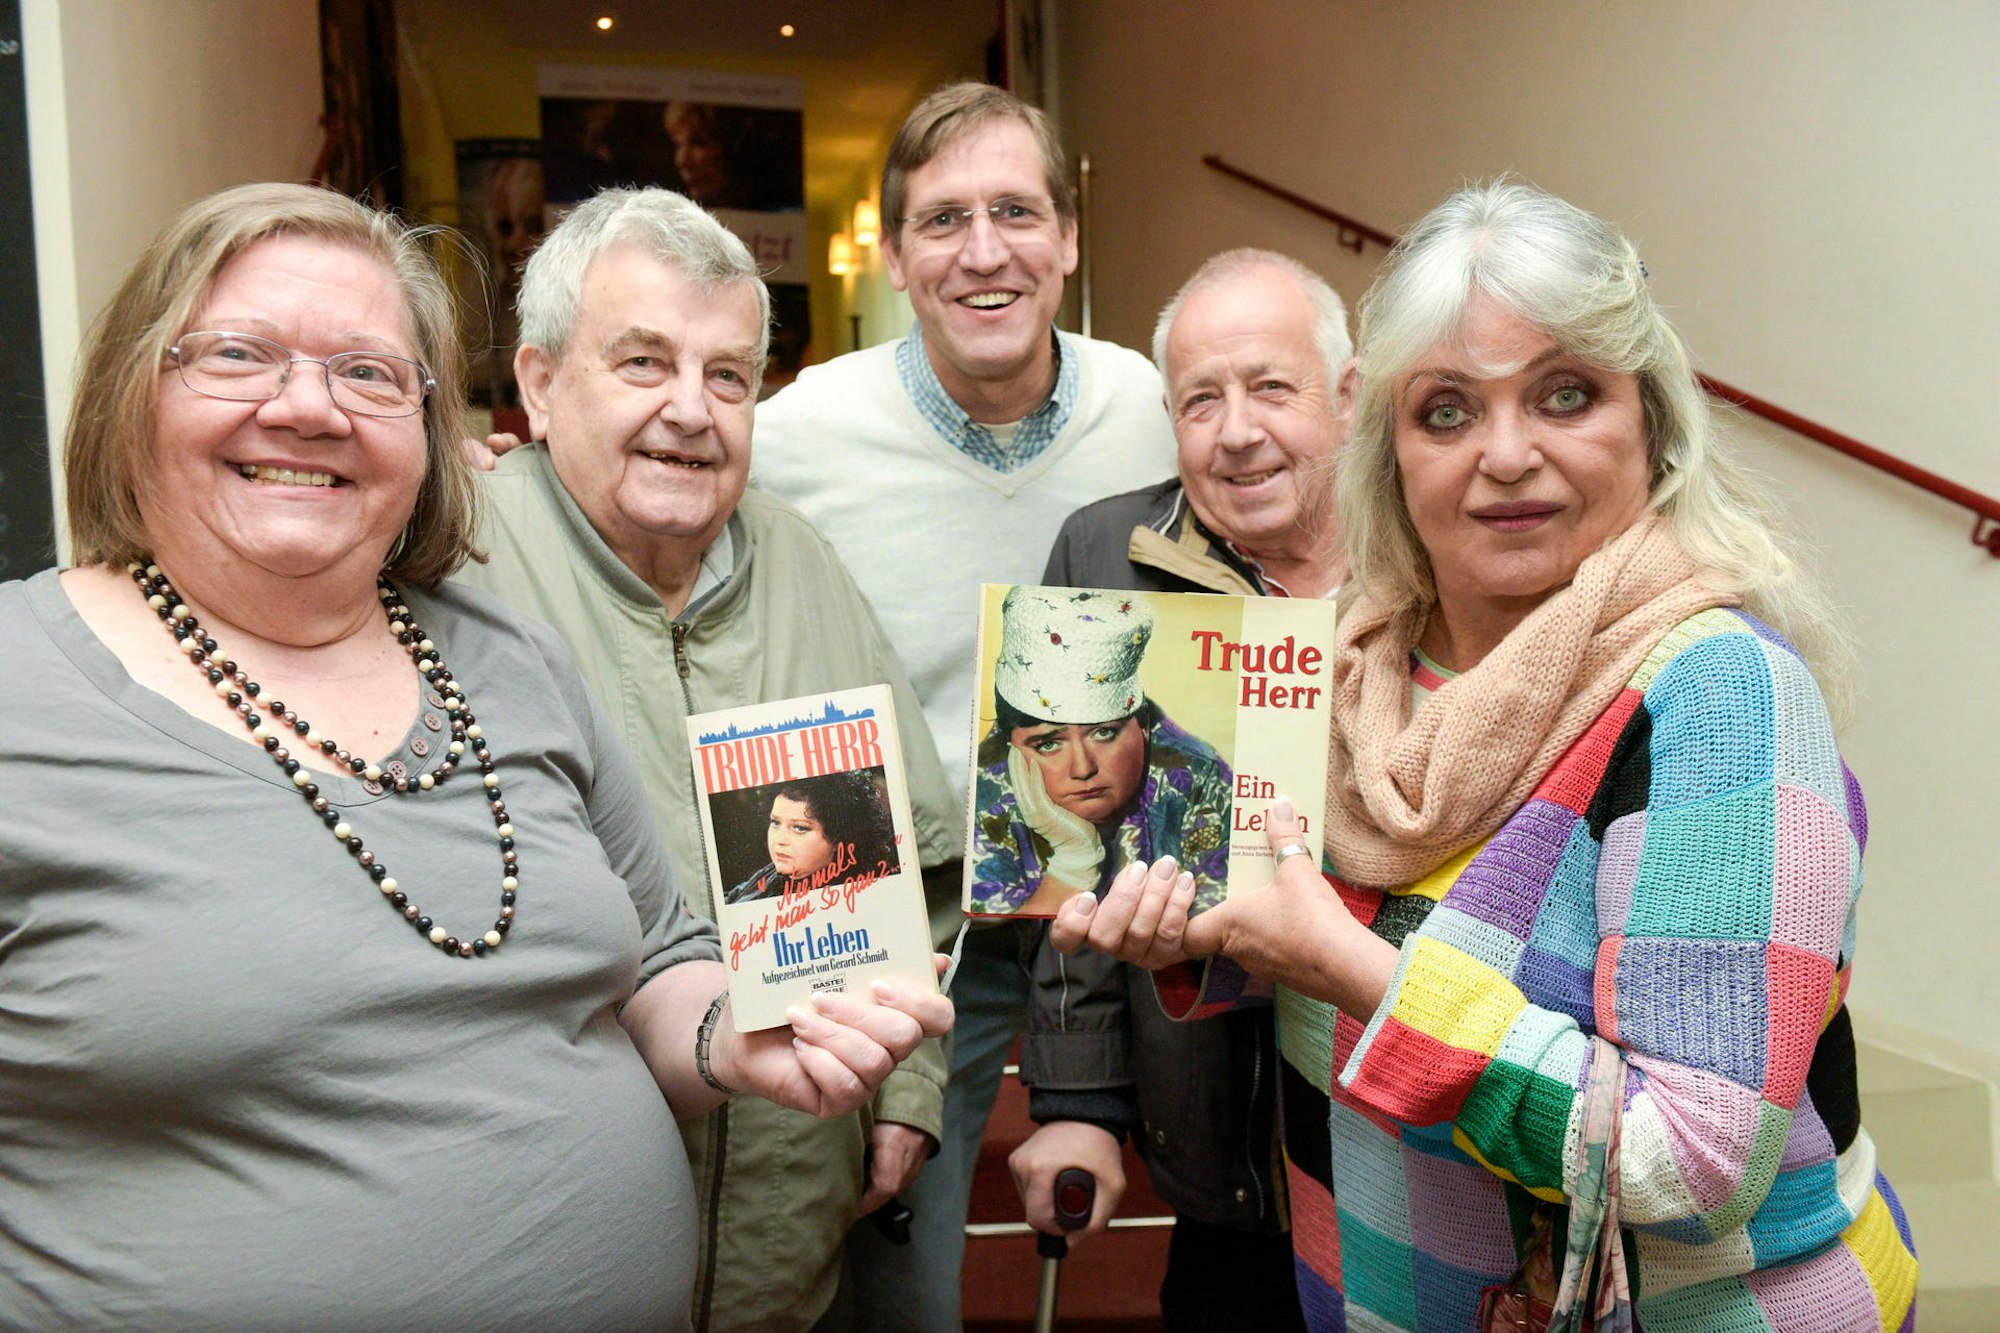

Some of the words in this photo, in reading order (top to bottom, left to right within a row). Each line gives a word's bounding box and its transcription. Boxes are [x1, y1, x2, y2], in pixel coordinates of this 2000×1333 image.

[1191, 630, 1323, 676] Trude
[1239, 676, 1322, 710] Herr
[695, 732, 797, 795] TRUDE
[800, 719, 884, 779] HERR
[1235, 774, 1276, 799] Ein
[1233, 807, 1309, 833] Len
[772, 932, 805, 967] Ihr
[805, 922, 870, 961] Leben
[761, 963, 816, 986] Aufgezeichnet
[816, 963, 831, 974] von
[830, 953, 858, 972] Gerard
[857, 948, 889, 966] Schmidt
[812, 978, 845, 990] BASTEI
